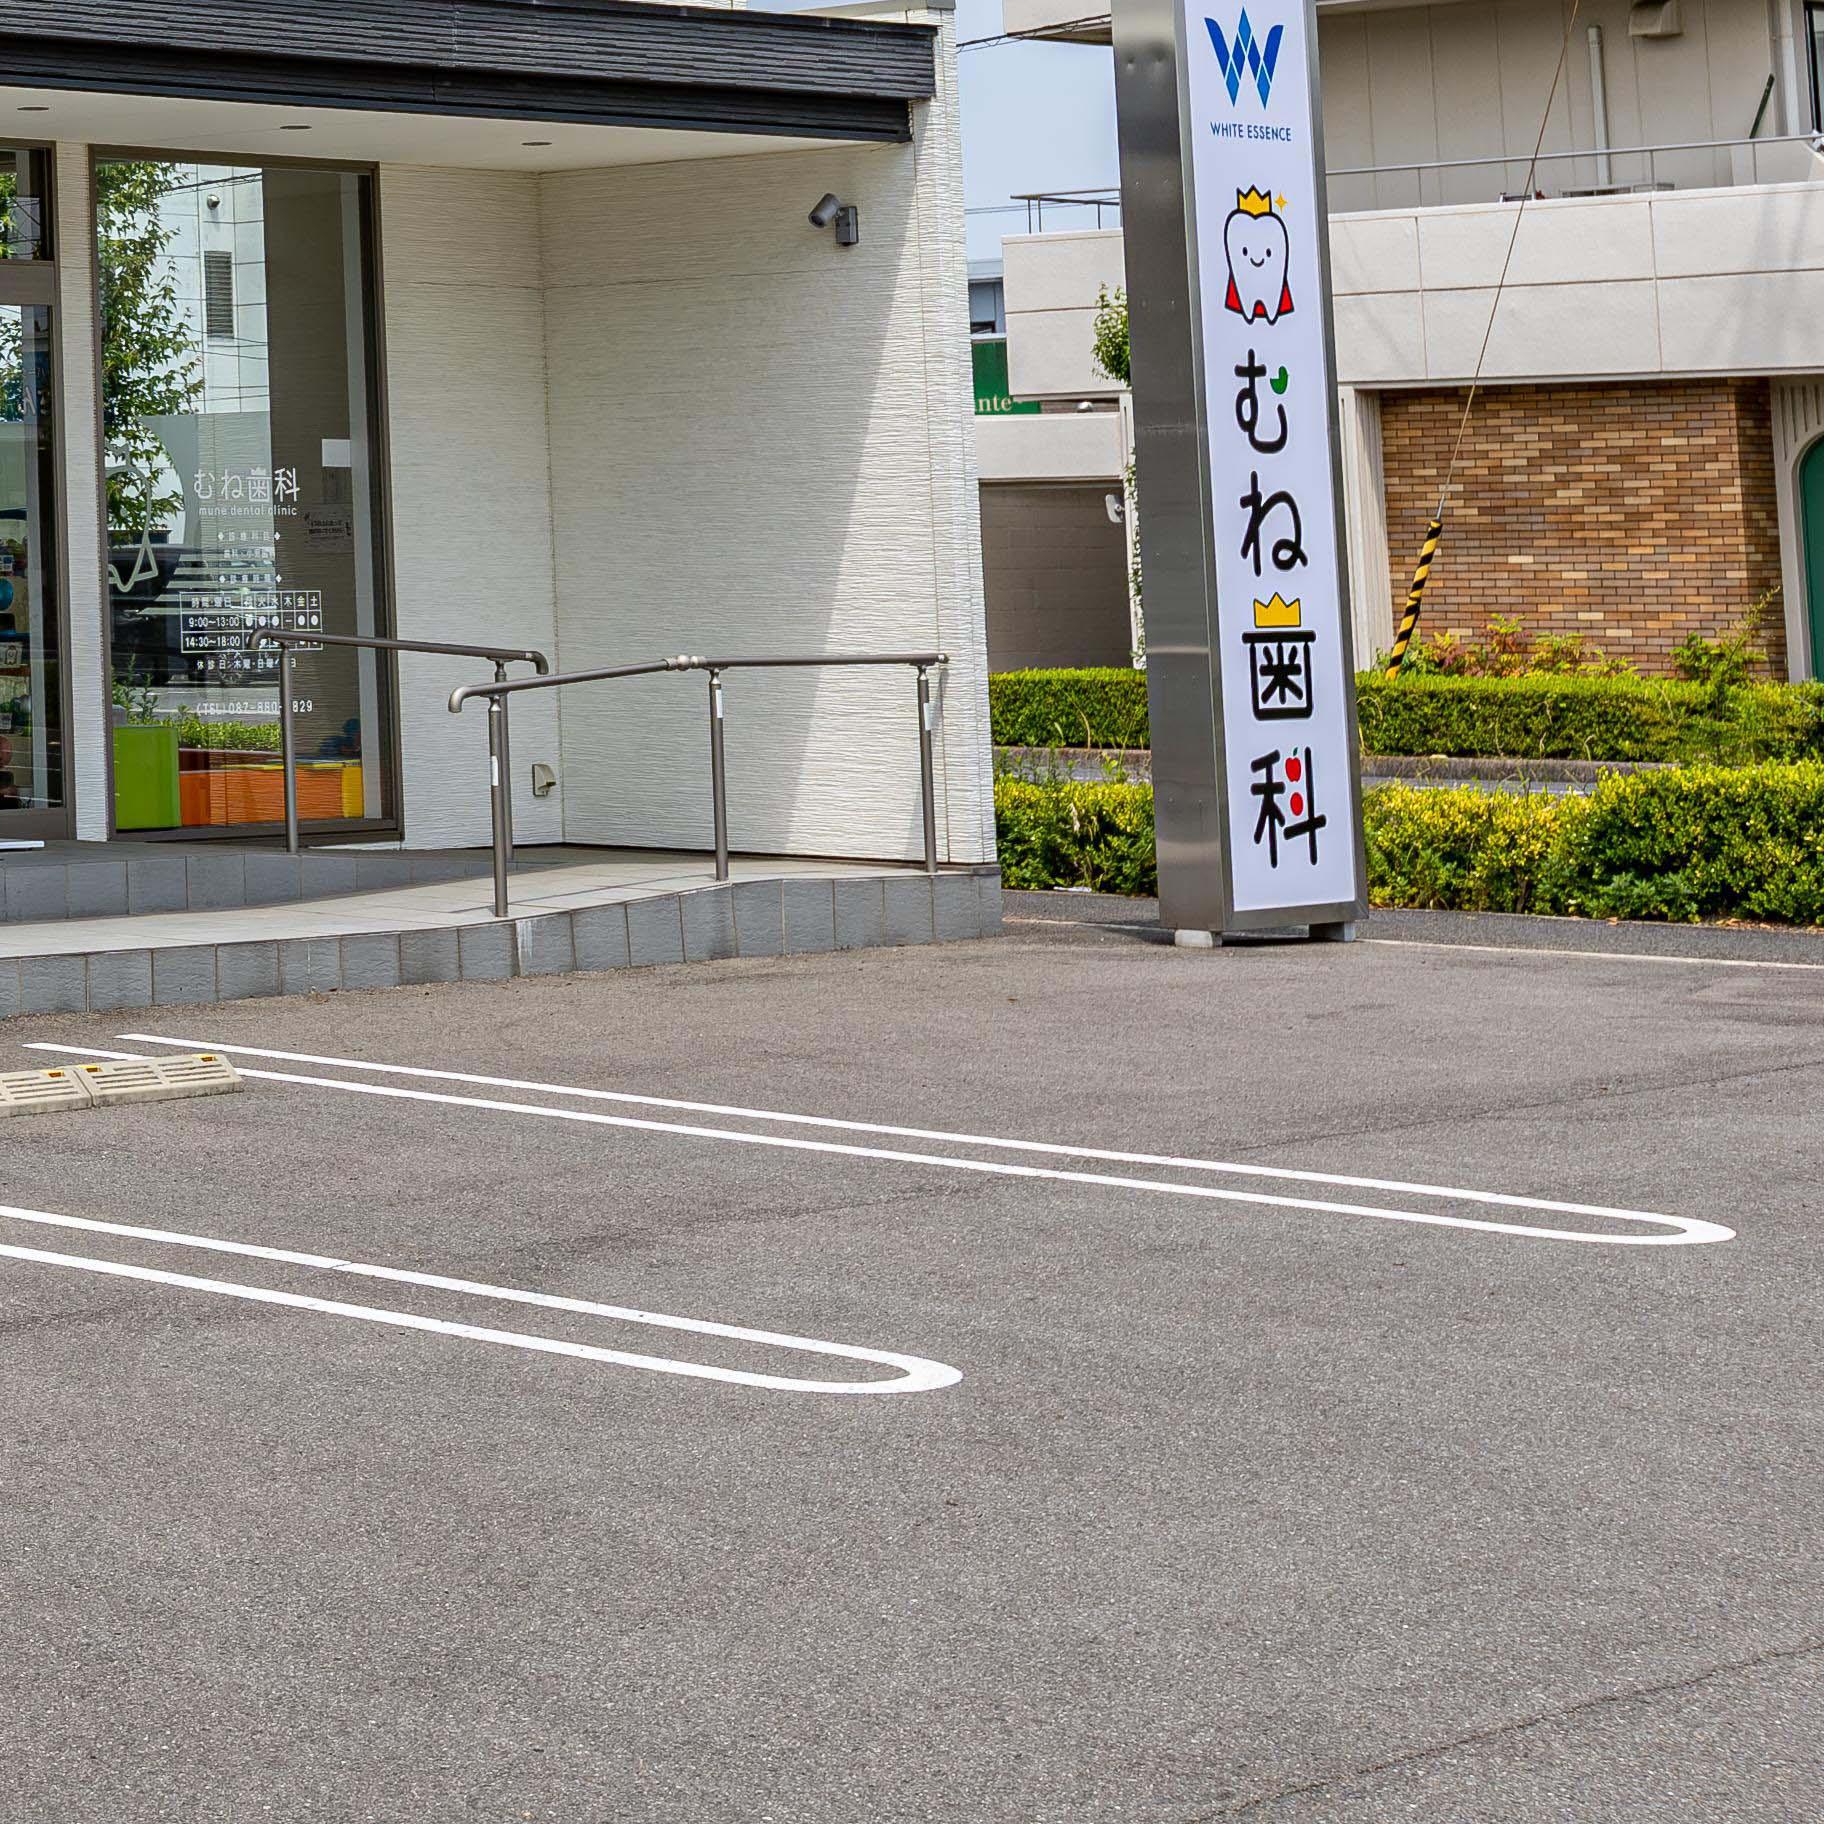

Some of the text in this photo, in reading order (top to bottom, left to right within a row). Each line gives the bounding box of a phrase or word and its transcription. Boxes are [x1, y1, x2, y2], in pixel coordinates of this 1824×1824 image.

[1210, 121, 1292, 142] WHITE ESSENCE
[193, 466, 301, 503] むね歯科
[198, 504, 298, 516] mune dental clinic
[297, 595, 306, 607] 金
[310, 595, 318, 607] 土
[1233, 348, 1327, 868] むね歯科
